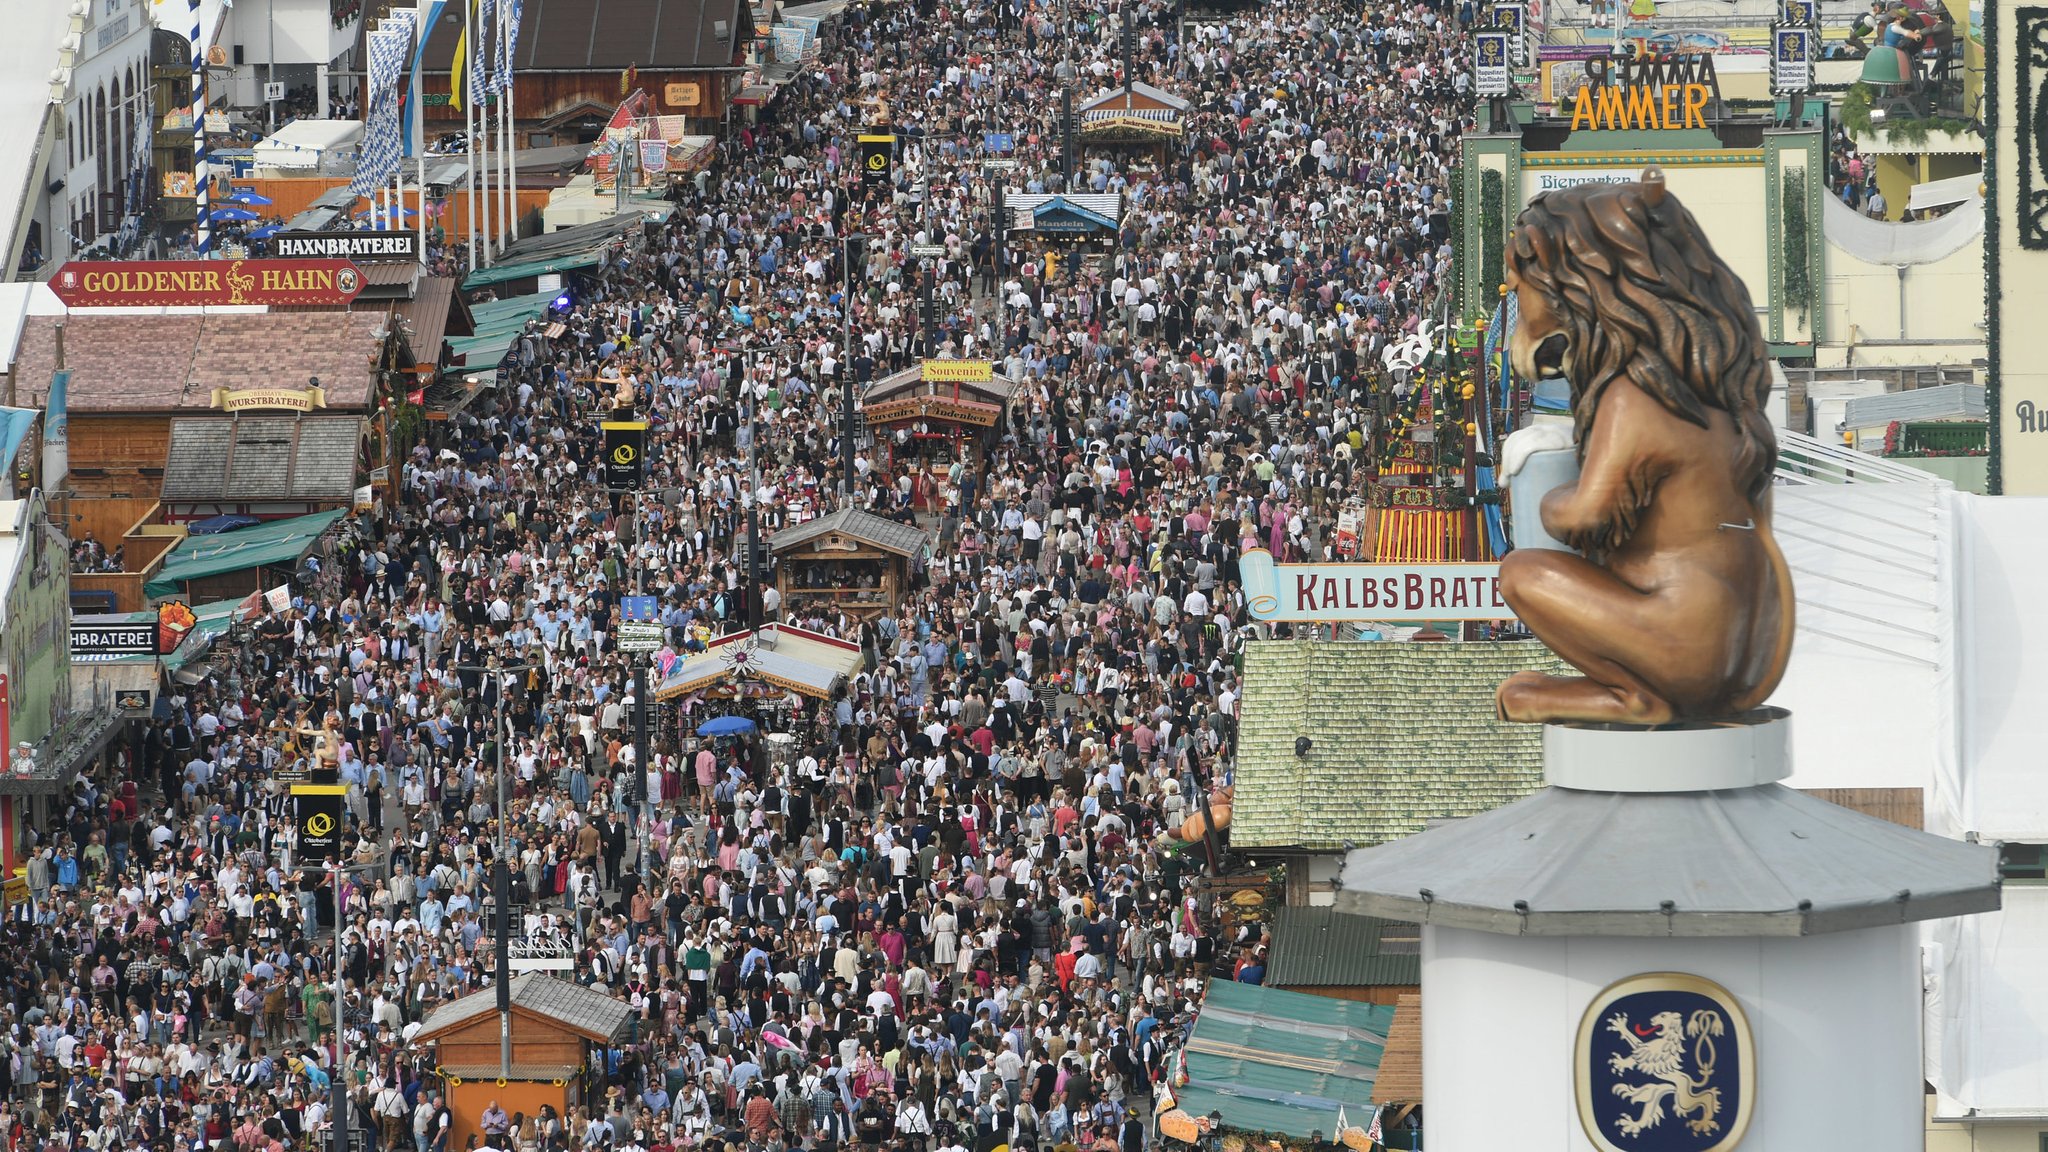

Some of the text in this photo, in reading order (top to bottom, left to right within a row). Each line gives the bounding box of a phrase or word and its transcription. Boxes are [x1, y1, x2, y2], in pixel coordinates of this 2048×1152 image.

[1571, 83, 1708, 131] AMMER
[278, 237, 412, 256] HAXNBRATEREI
[83, 271, 222, 293] GOLDENER
[261, 269, 334, 290] HAHN
[929, 366, 984, 376] Souvenirs
[228, 396, 308, 408] WURSTBRATEREI
[933, 407, 987, 423] Andenken
[71, 632, 152, 645] HBRATEREI
